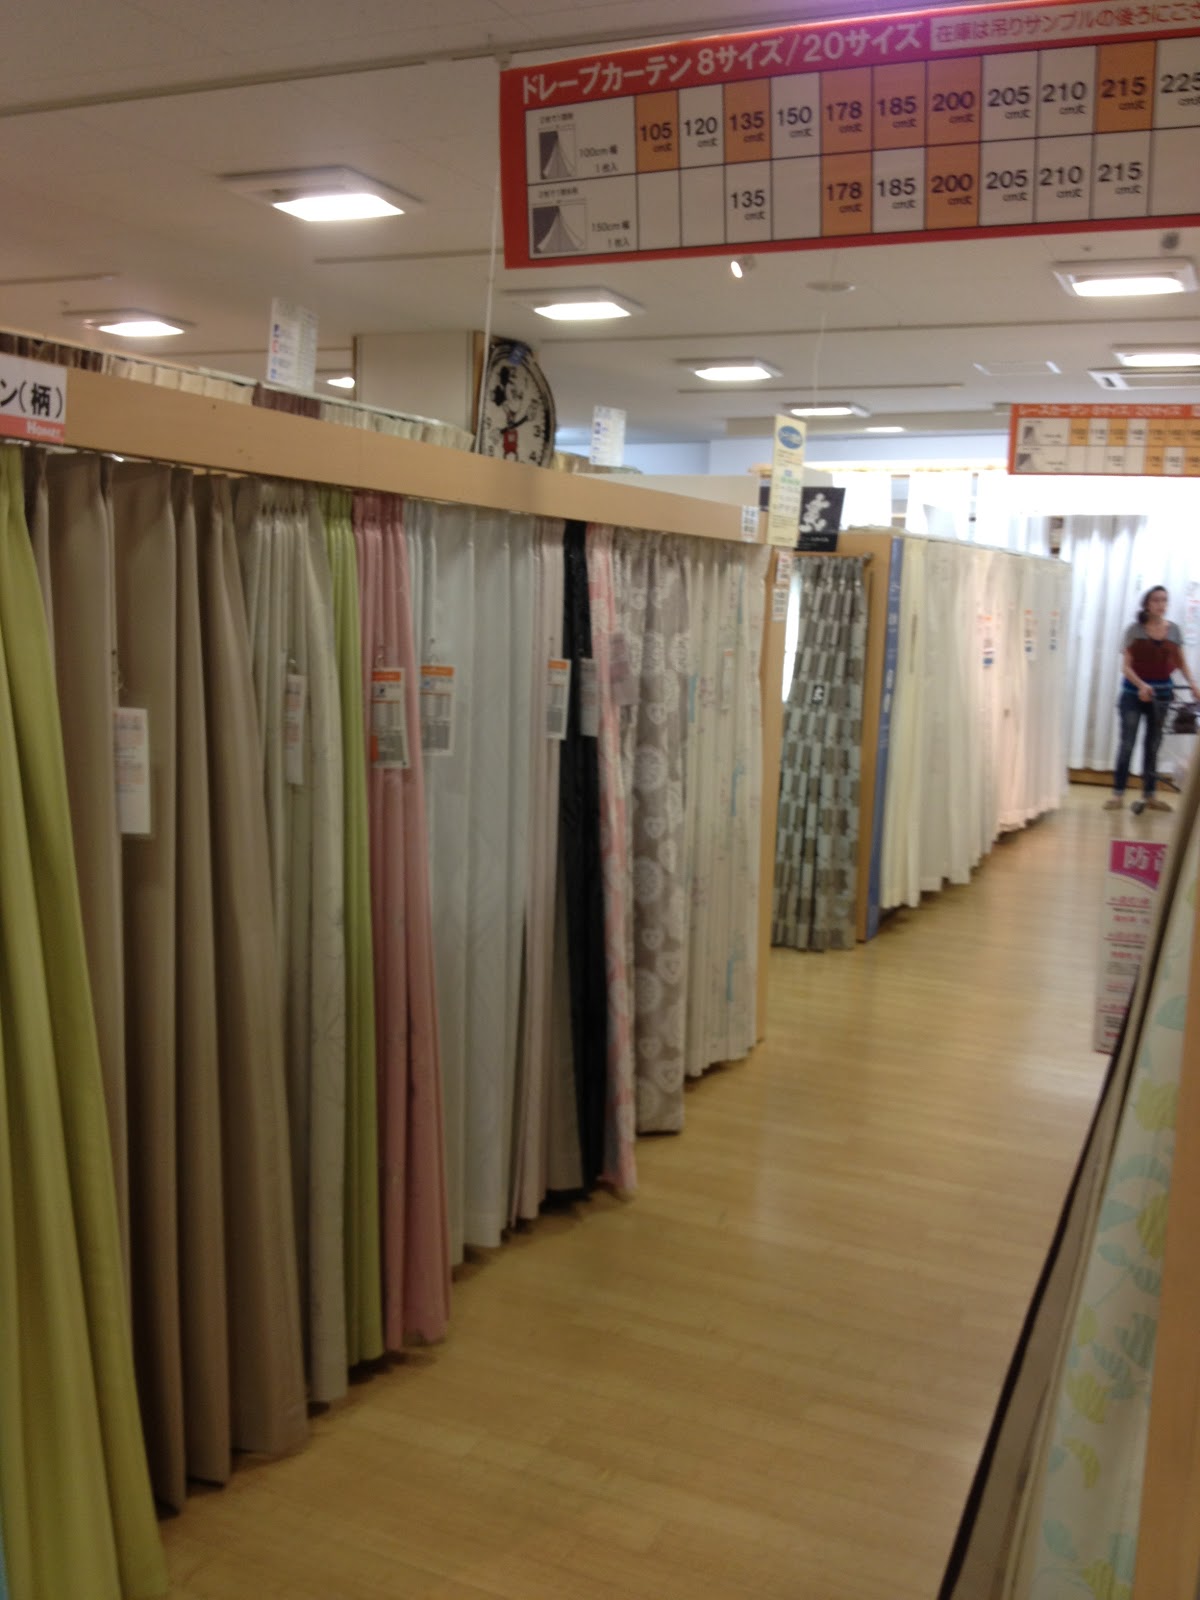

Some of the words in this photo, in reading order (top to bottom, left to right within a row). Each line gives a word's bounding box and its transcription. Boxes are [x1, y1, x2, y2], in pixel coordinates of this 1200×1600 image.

[639, 122, 673, 142] 105
[684, 116, 718, 136] 120
[730, 111, 765, 131] 135
[777, 106, 813, 126] 150
[826, 101, 863, 121] 178
[877, 96, 917, 116] 185
[932, 91, 975, 112] 200
[987, 86, 1031, 108] 205
[1042, 81, 1087, 103] 210
[1102, 76, 1146, 98] 215
[1160, 72, 1200, 94] 225
[730, 189, 766, 209] 135
[826, 182, 863, 201] 178
[876, 178, 917, 198] 185
[931, 173, 973, 194] 200
[985, 169, 1028, 190] 205
[1039, 165, 1083, 187] 210
[1098, 161, 1143, 183] 215
